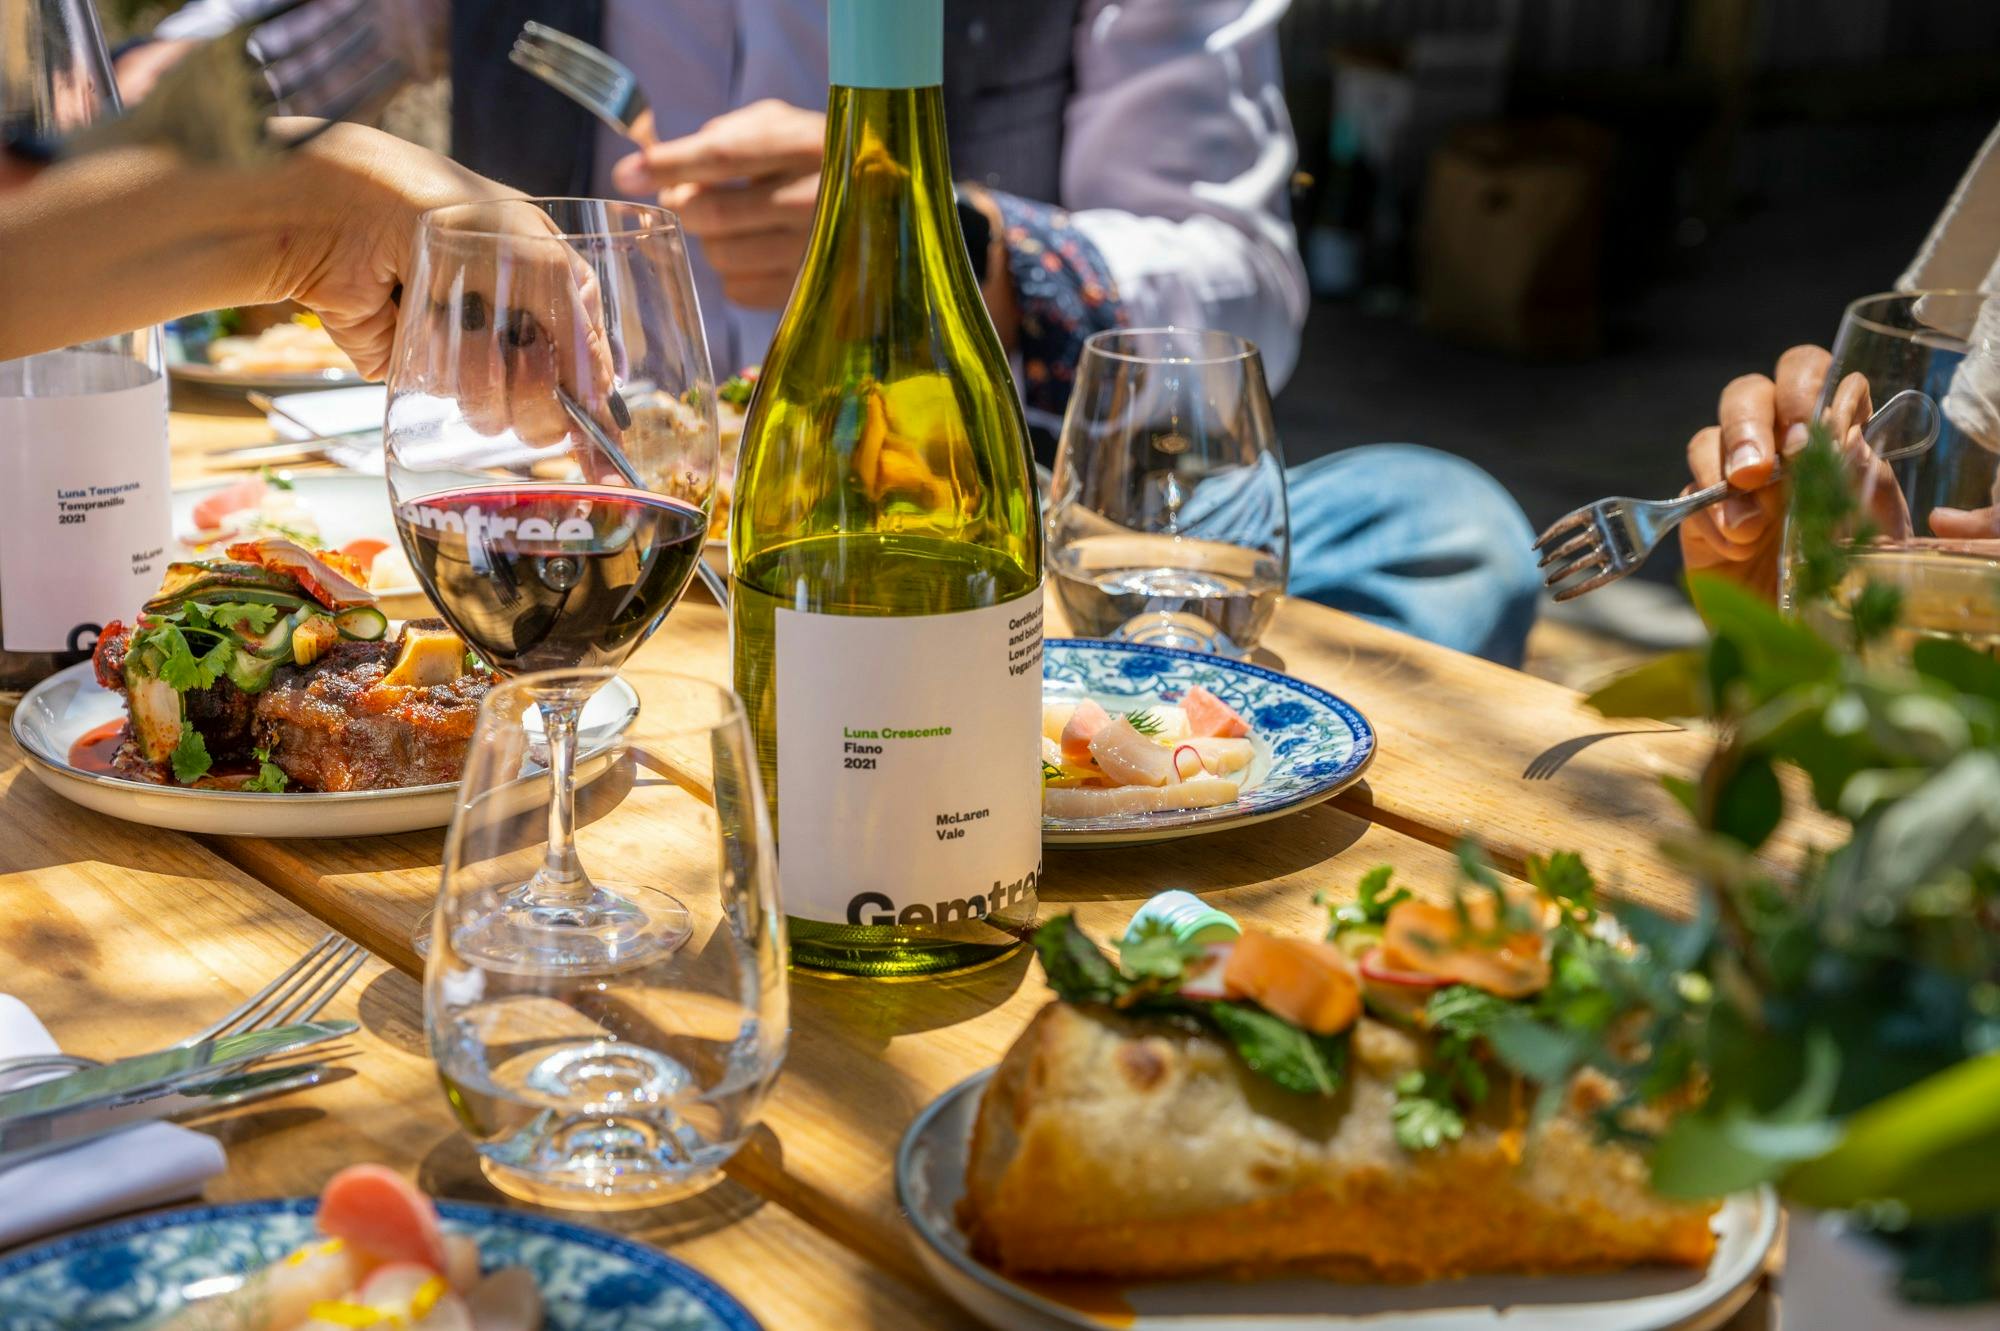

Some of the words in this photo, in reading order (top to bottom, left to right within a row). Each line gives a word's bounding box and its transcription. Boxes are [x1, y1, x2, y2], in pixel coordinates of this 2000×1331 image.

[57, 489, 86, 499] Luna
[89, 482, 140, 496] Temprana
[58, 497, 125, 511] Tempranillo
[59, 513, 86, 525] 2021
[1009, 631, 1024, 646] and
[1009, 648, 1025, 661] Low
[1009, 660, 1032, 676] Vegan
[844, 727, 879, 739] Luna
[881, 726, 952, 739] Crescente
[844, 742, 883, 754] Fiano
[844, 758, 876, 769] 2021
[936, 808, 990, 826] McLaren
[936, 827, 966, 841] Vale
